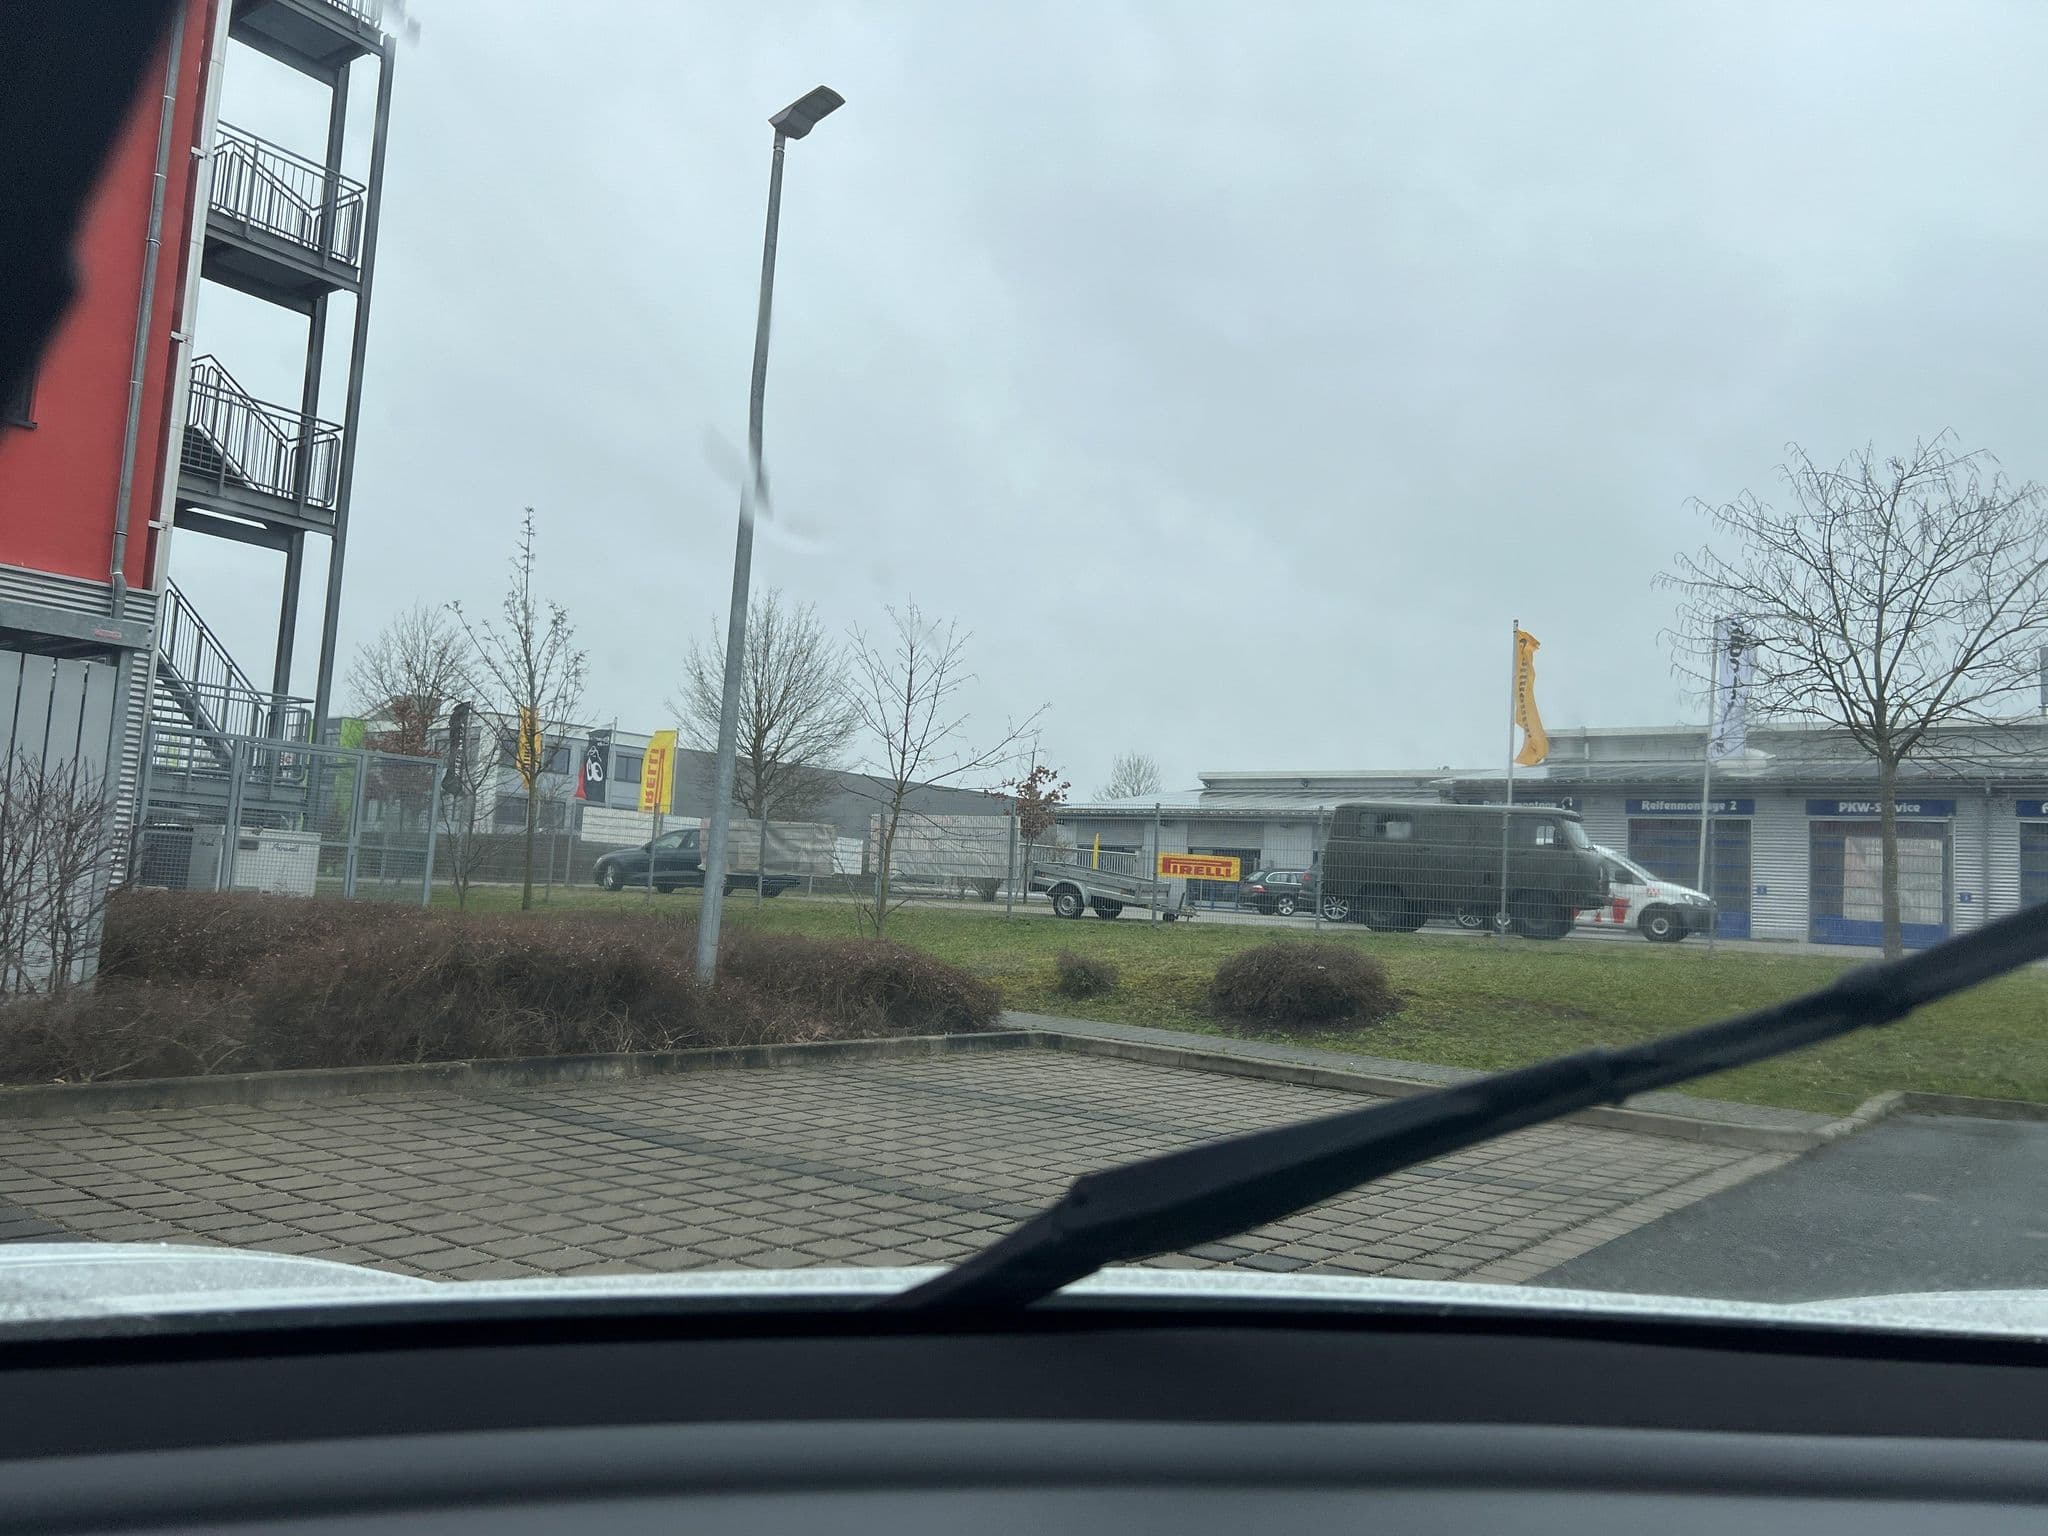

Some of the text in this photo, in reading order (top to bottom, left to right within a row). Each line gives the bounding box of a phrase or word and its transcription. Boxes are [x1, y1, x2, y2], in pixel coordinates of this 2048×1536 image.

[1641, 800, 1737, 812] Reifenmonge 2
[1838, 802, 1921, 813] PKW-Svice
[1162, 857, 1232, 877] PIRELLI
